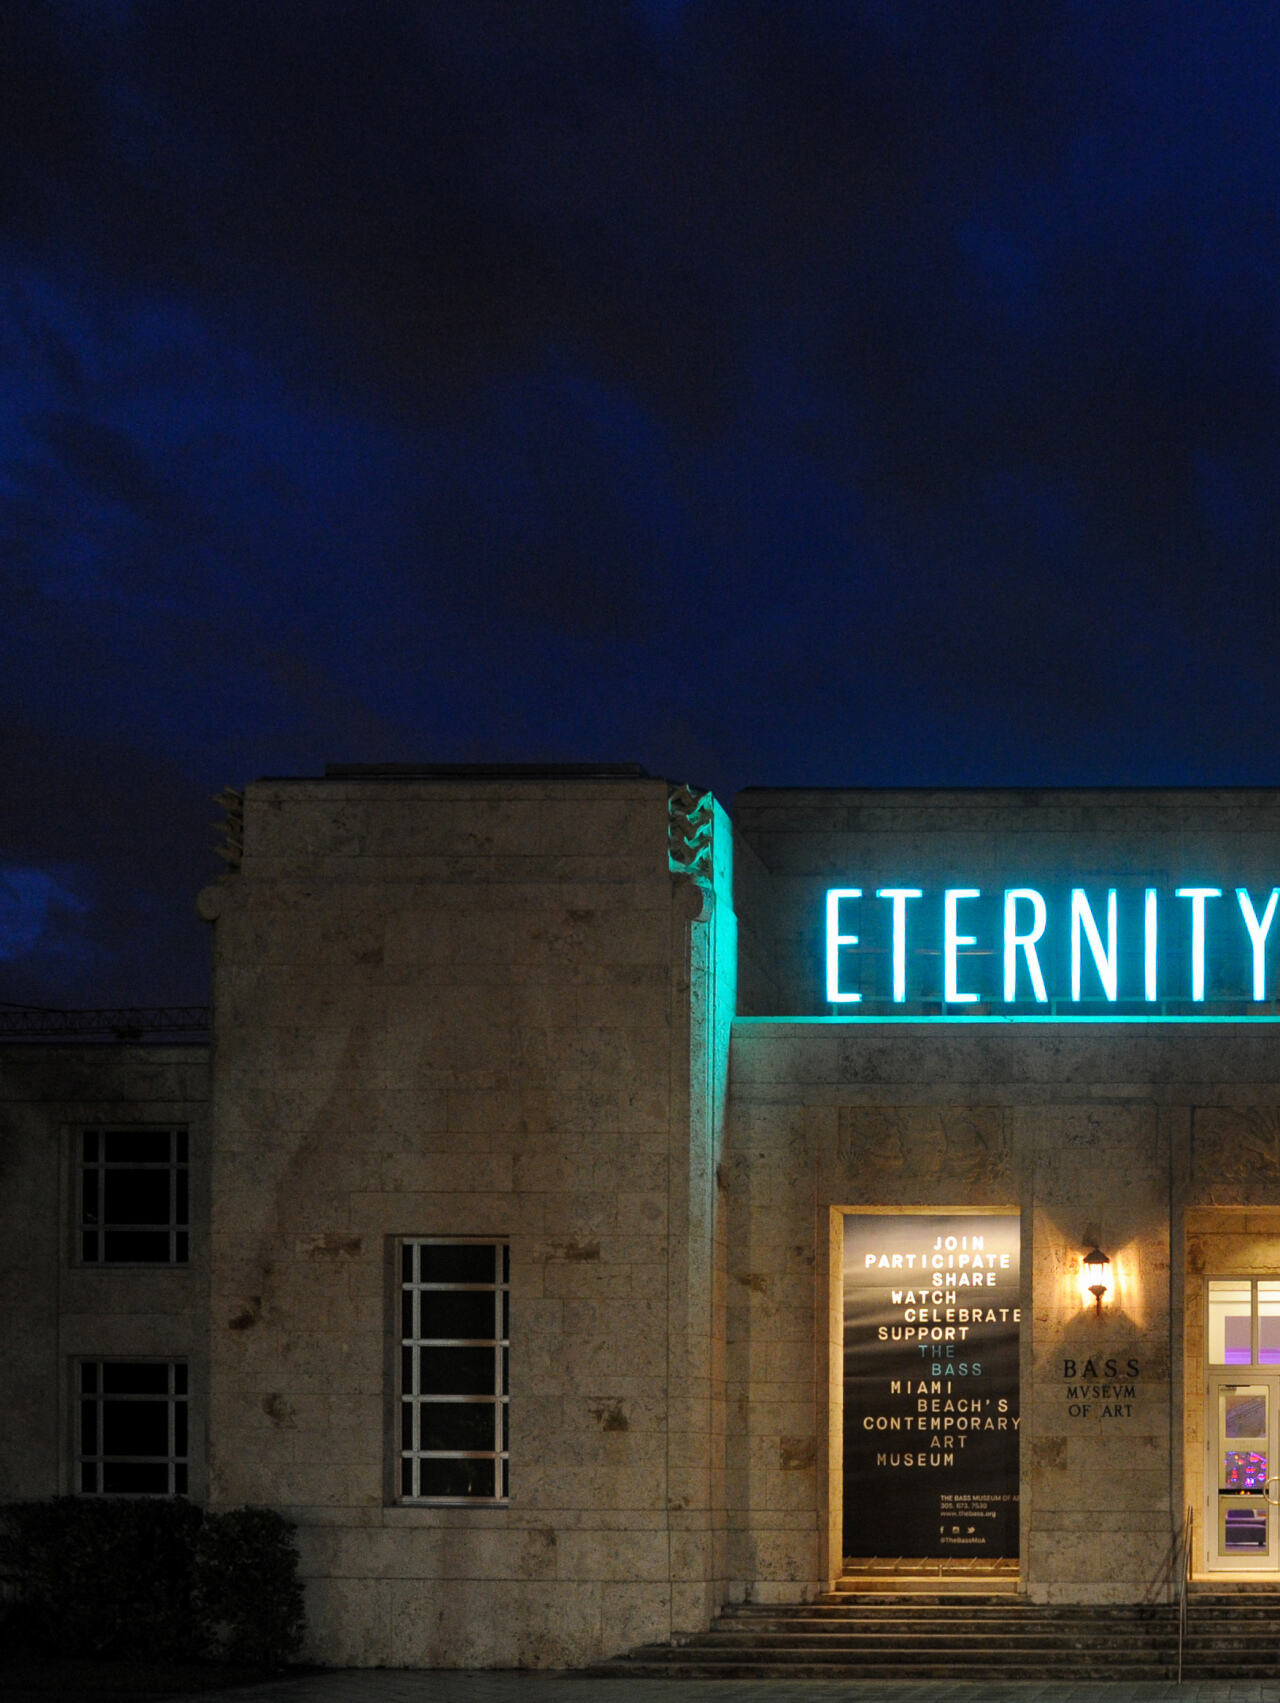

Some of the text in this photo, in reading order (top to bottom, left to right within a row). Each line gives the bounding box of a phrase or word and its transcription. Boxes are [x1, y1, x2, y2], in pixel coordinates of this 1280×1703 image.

[826, 888, 1280, 1003] ETERNITY
[934, 1236, 984, 1251] JOIN
[865, 1254, 1010, 1268] PARTICIPATE
[932, 1272, 996, 1286] SHARE
[892, 1291, 956, 1304] WATCH
[905, 1309, 1021, 1323] CELEBRATE
[878, 1327, 969, 1340] SUPPORT
[918, 1345, 955, 1358] THE
[932, 1363, 982, 1376] BASS
[1063, 1359, 1140, 1378] BASS
[891, 1381, 952, 1394] MIAMI
[917, 1399, 1008, 1412] BEACH'S
[1068, 1404, 1134, 1417] OF ART
[863, 1417, 1020, 1430] CONTEMPORARY
[930, 1436, 968, 1448] ART
[877, 1453, 954, 1466] MUSEUM
